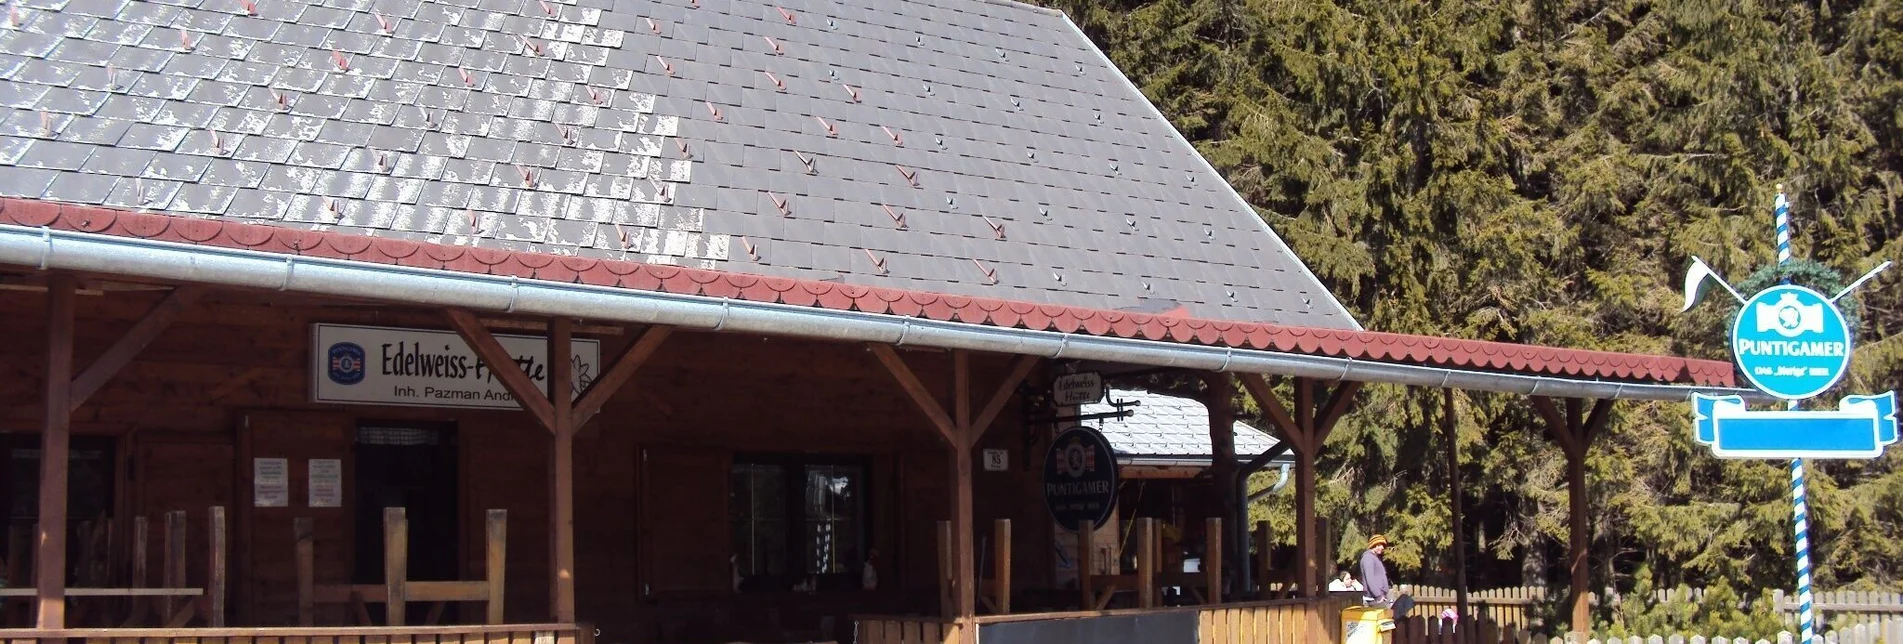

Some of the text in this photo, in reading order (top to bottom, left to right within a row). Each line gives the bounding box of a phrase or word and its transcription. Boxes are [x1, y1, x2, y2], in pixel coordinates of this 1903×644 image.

[1738, 338, 1844, 356] PUNTIGAMER
[394, 385, 420, 398] Inh.
[424, 386, 480, 400] Pazman
[1046, 480, 1109, 497] PUNTIGAMER
